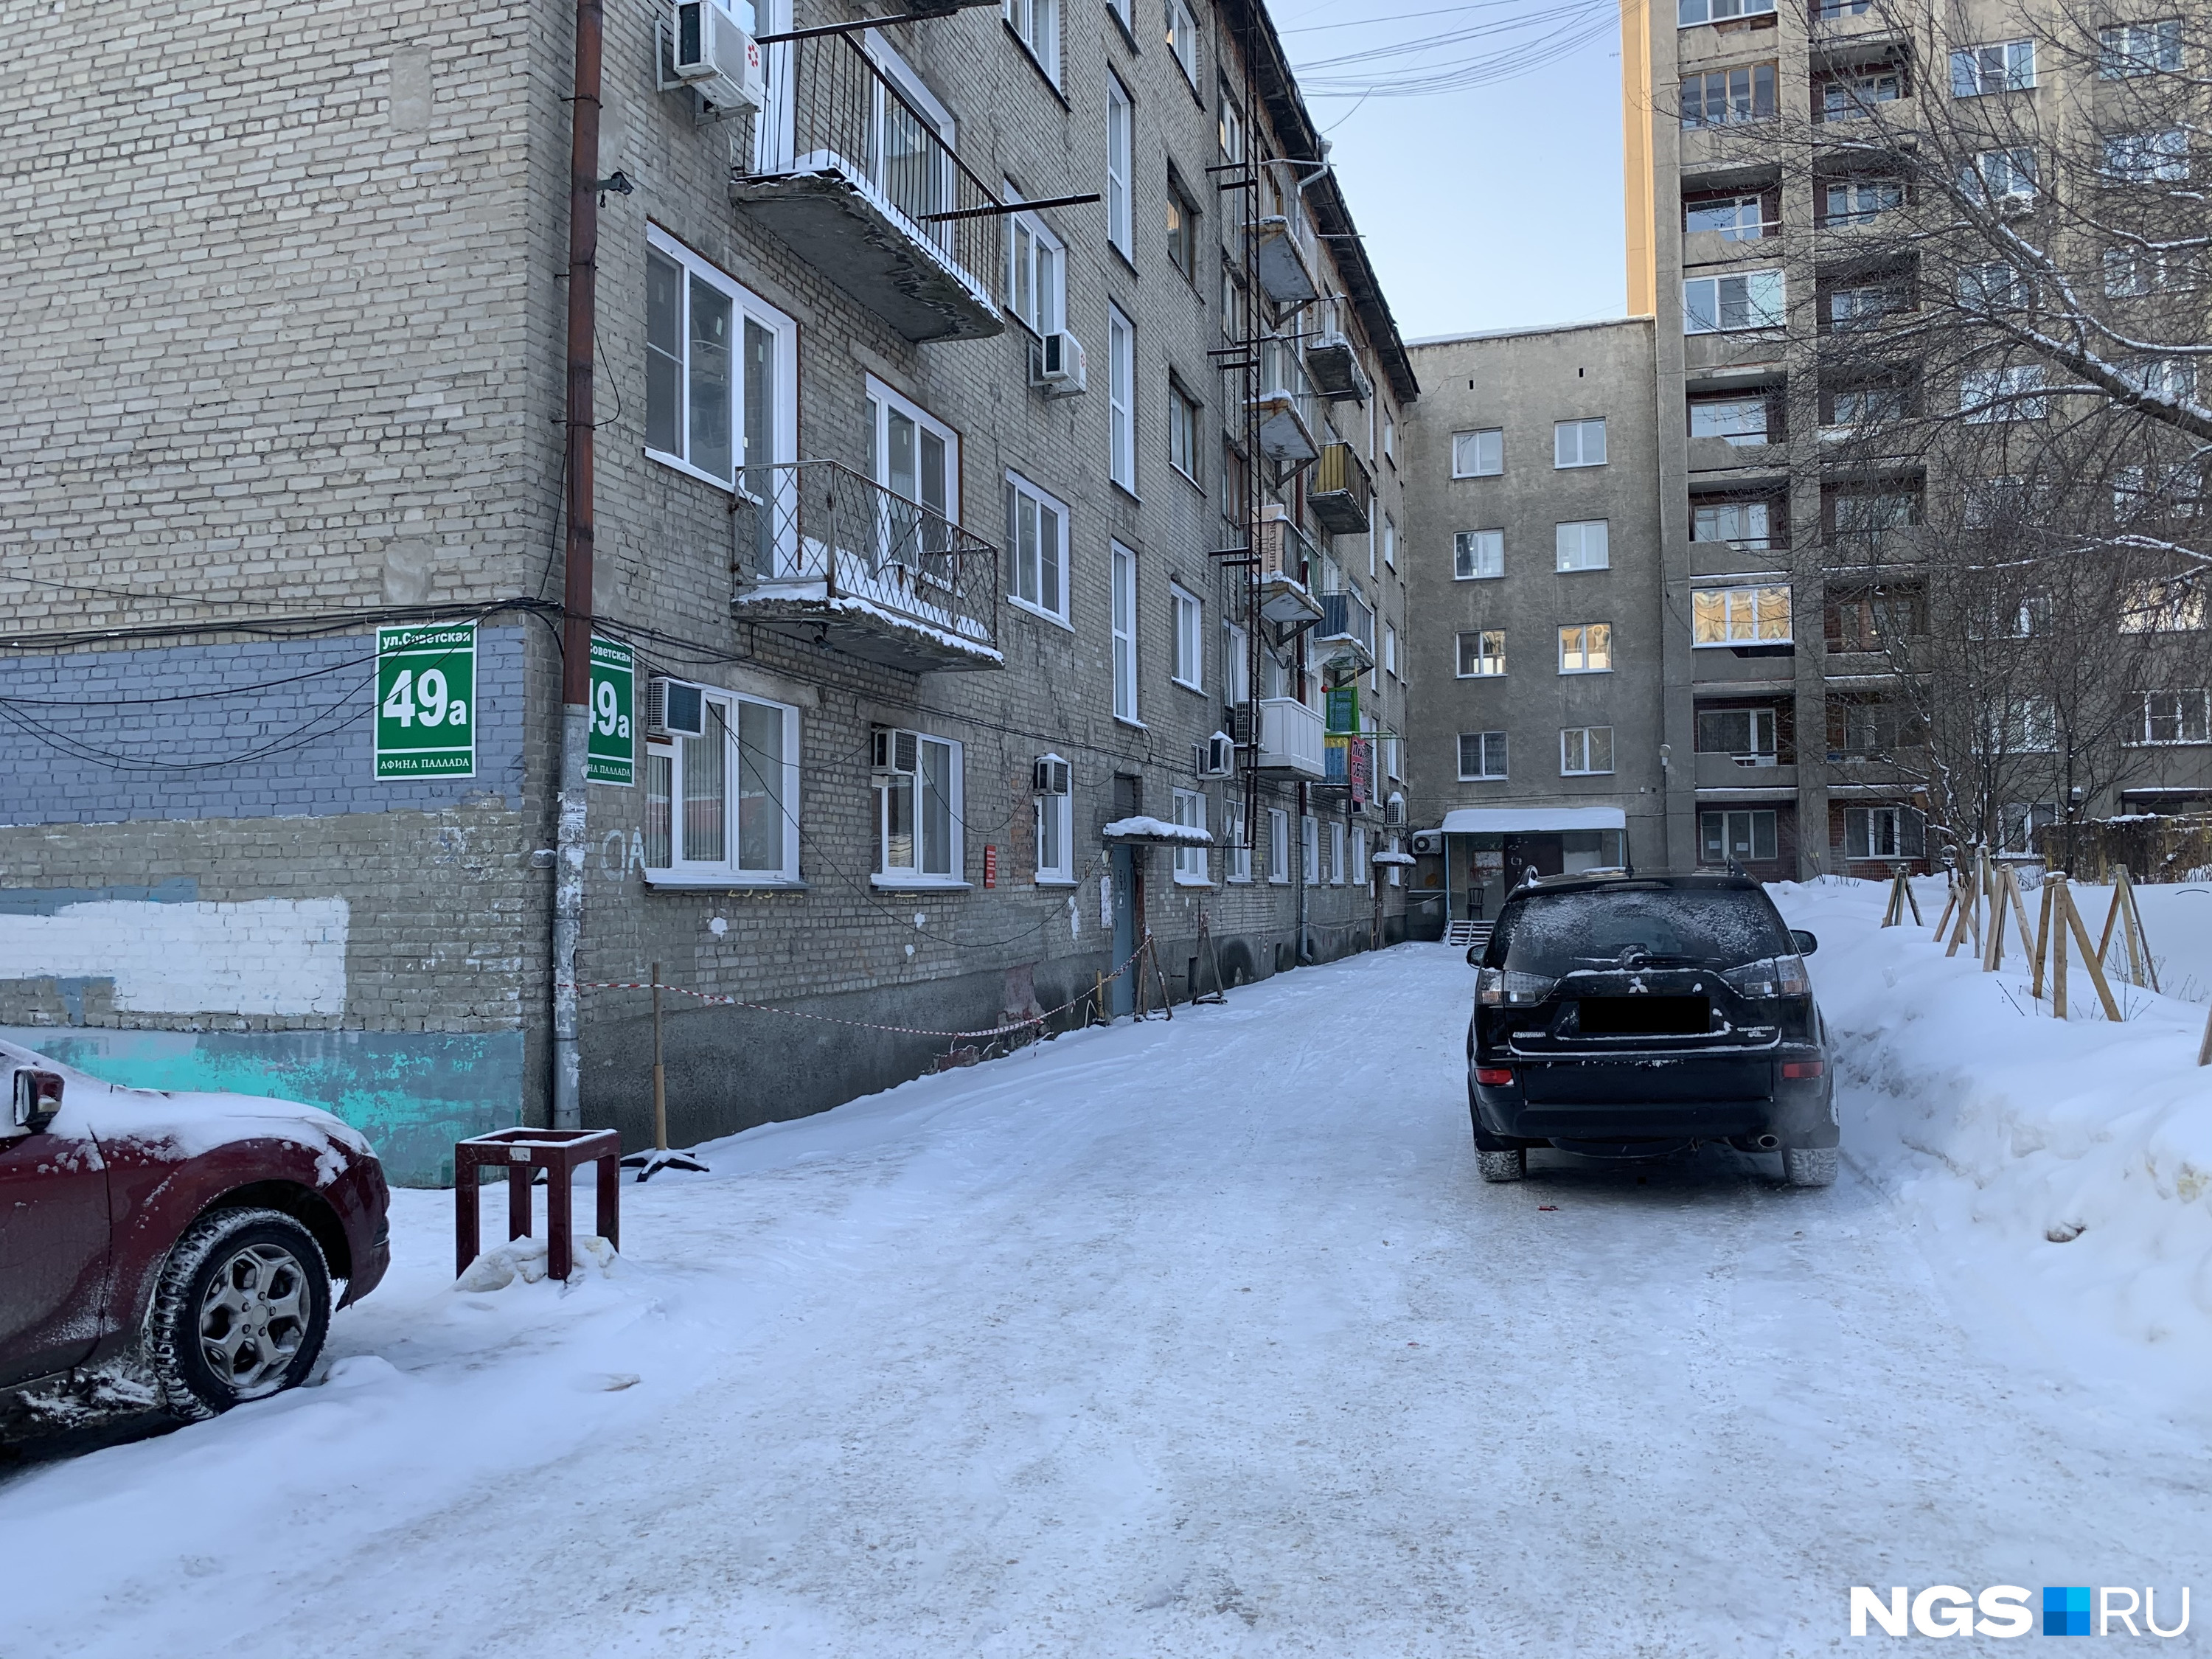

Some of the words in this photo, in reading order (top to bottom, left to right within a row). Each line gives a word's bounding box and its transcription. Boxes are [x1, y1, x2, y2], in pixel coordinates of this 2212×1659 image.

[590, 641, 631, 663] оветская
[383, 668, 467, 727] 49а
[380, 760, 418, 769] АФИНА
